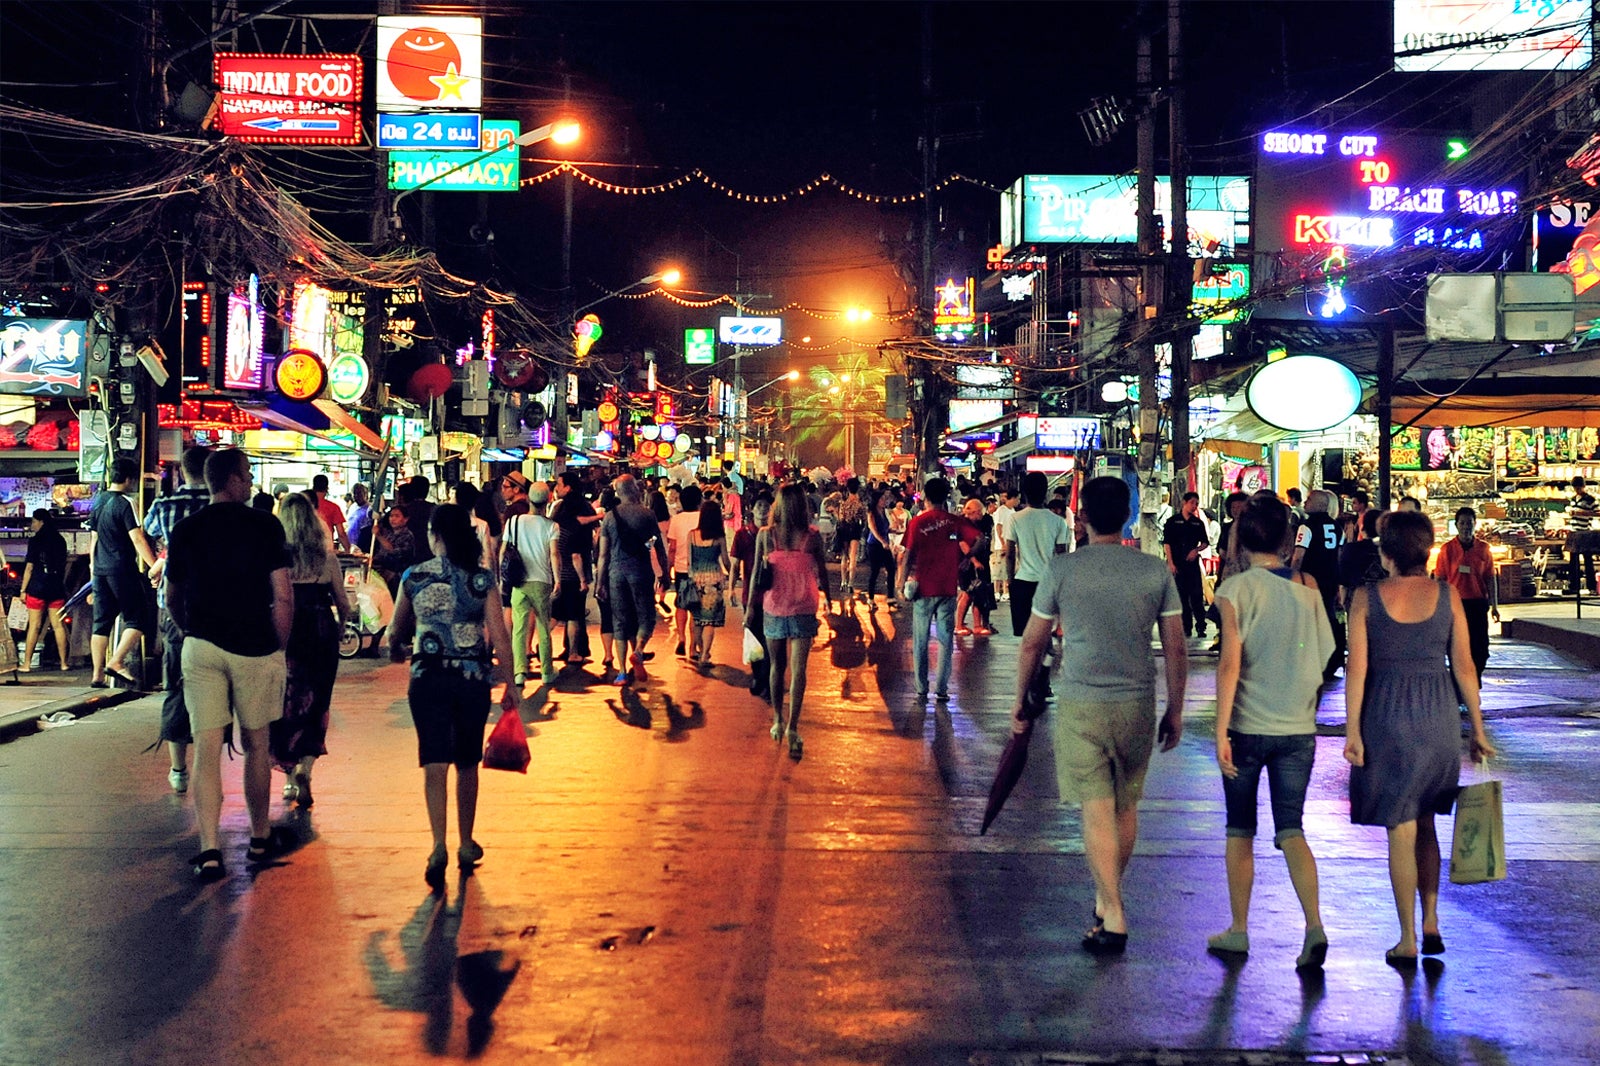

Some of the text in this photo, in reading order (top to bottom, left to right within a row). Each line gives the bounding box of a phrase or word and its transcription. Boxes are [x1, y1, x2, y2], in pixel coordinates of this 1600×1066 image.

[223, 71, 352, 97] INDIAN FOOD
[223, 99, 294, 114] NAVRANG
[412, 121, 443, 141] 24
[1263, 132, 1378, 156] SHORT CUT
[393, 161, 514, 186] PHARMACY
[1360, 161, 1390, 183] TO
[1368, 186, 1518, 215] BEACH ROAD
[1323, 524, 1337, 549] 5
